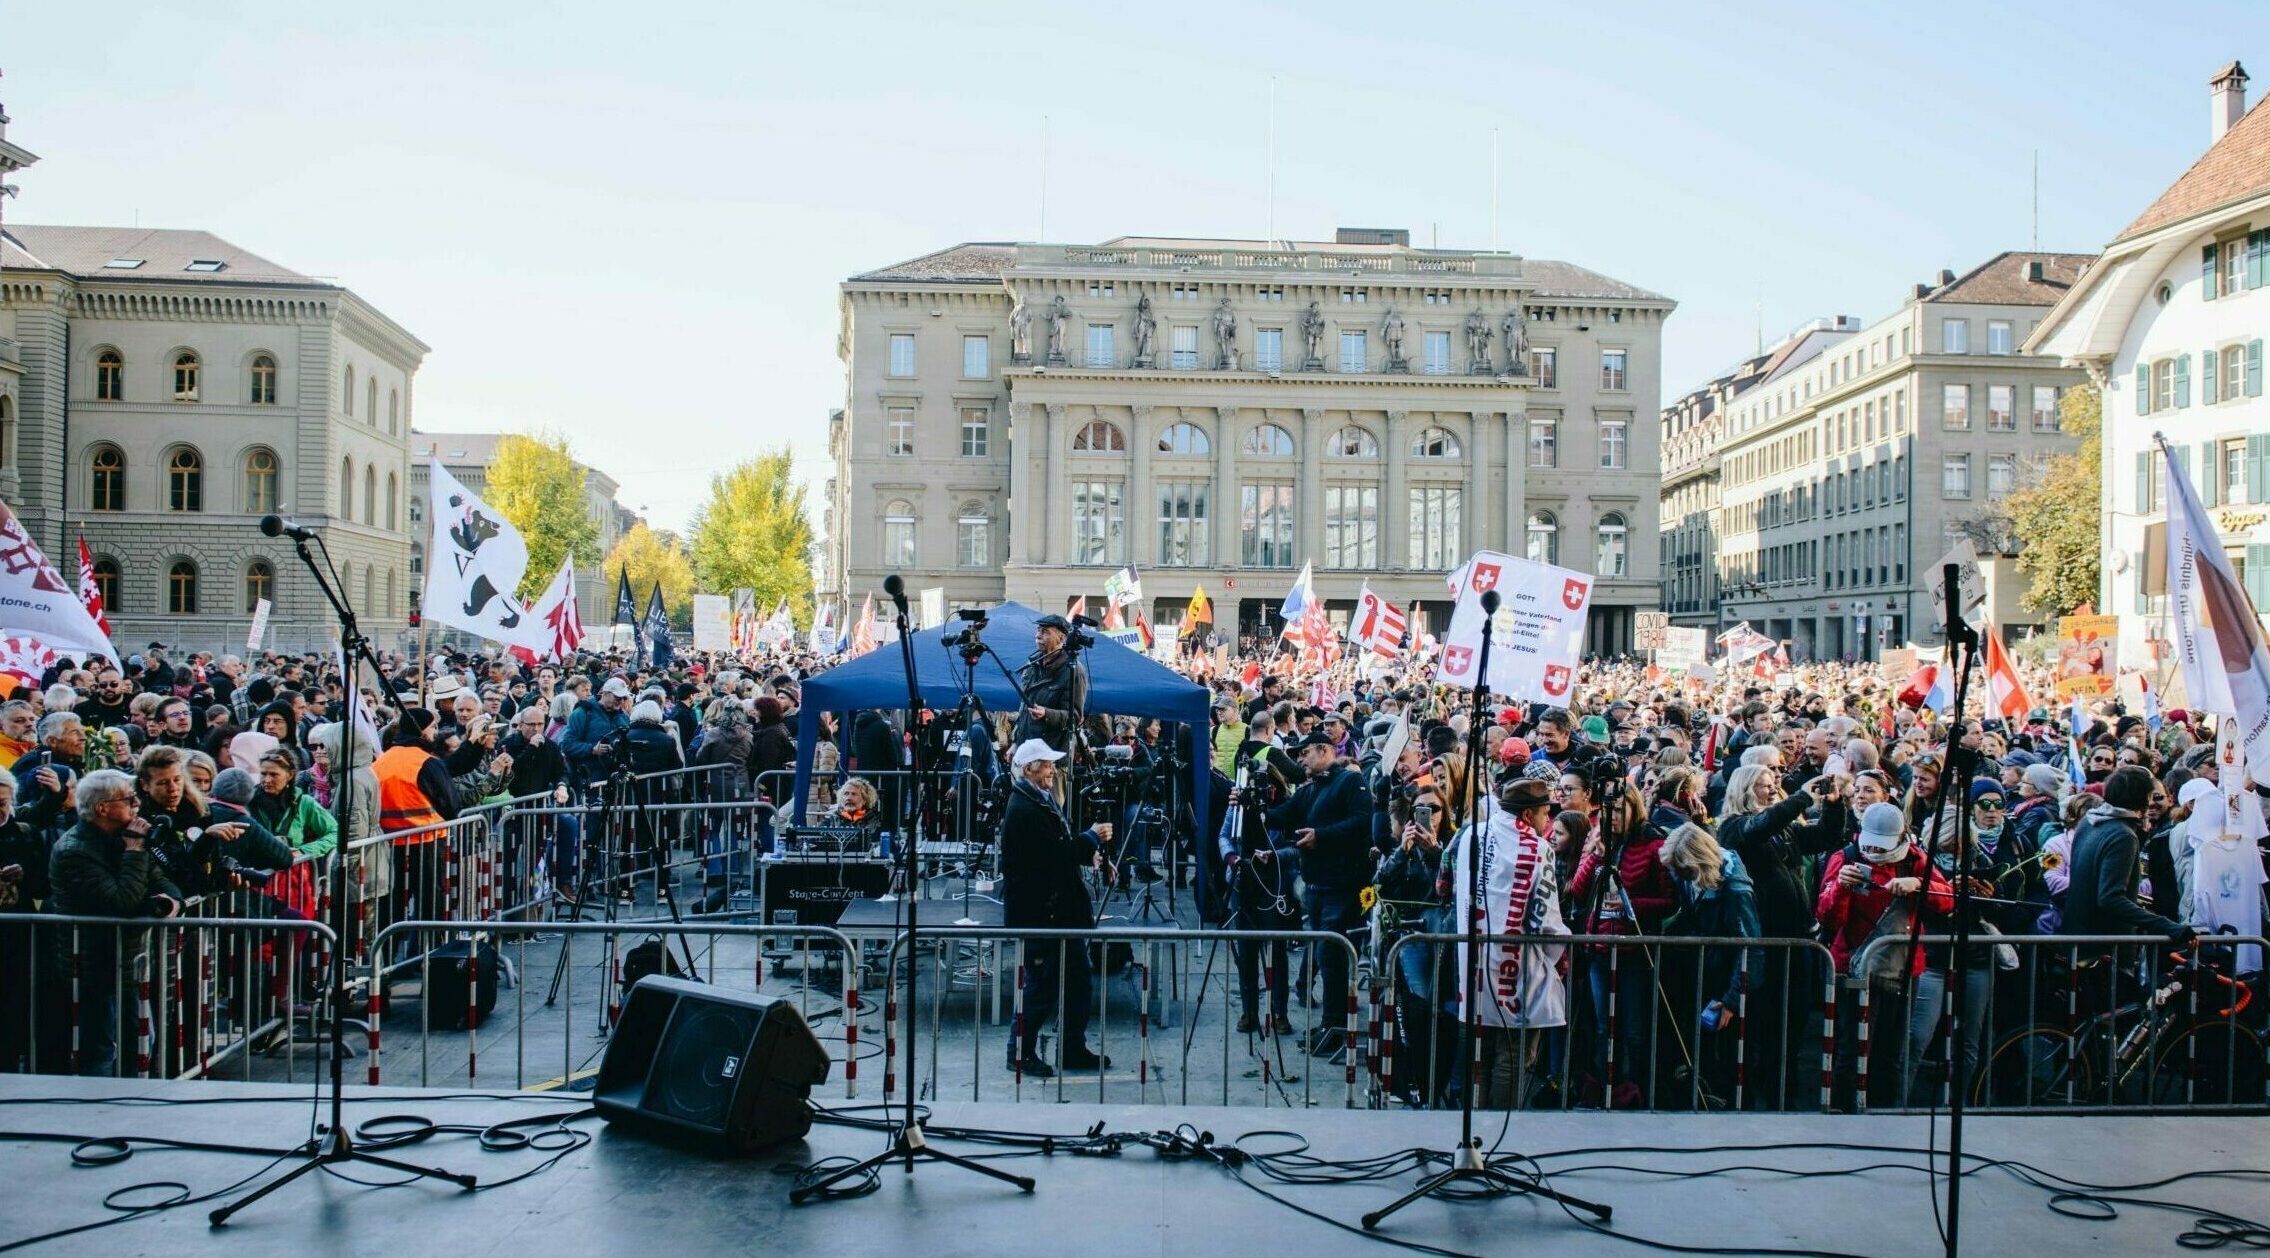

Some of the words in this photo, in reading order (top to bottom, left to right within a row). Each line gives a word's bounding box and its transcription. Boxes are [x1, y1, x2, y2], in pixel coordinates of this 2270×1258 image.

[1516, 593, 1536, 602] GOTT
[1636, 613, 1668, 630] COVID
[1638, 629, 1666, 649] 1984
[2070, 685, 2096, 695] NEIN
